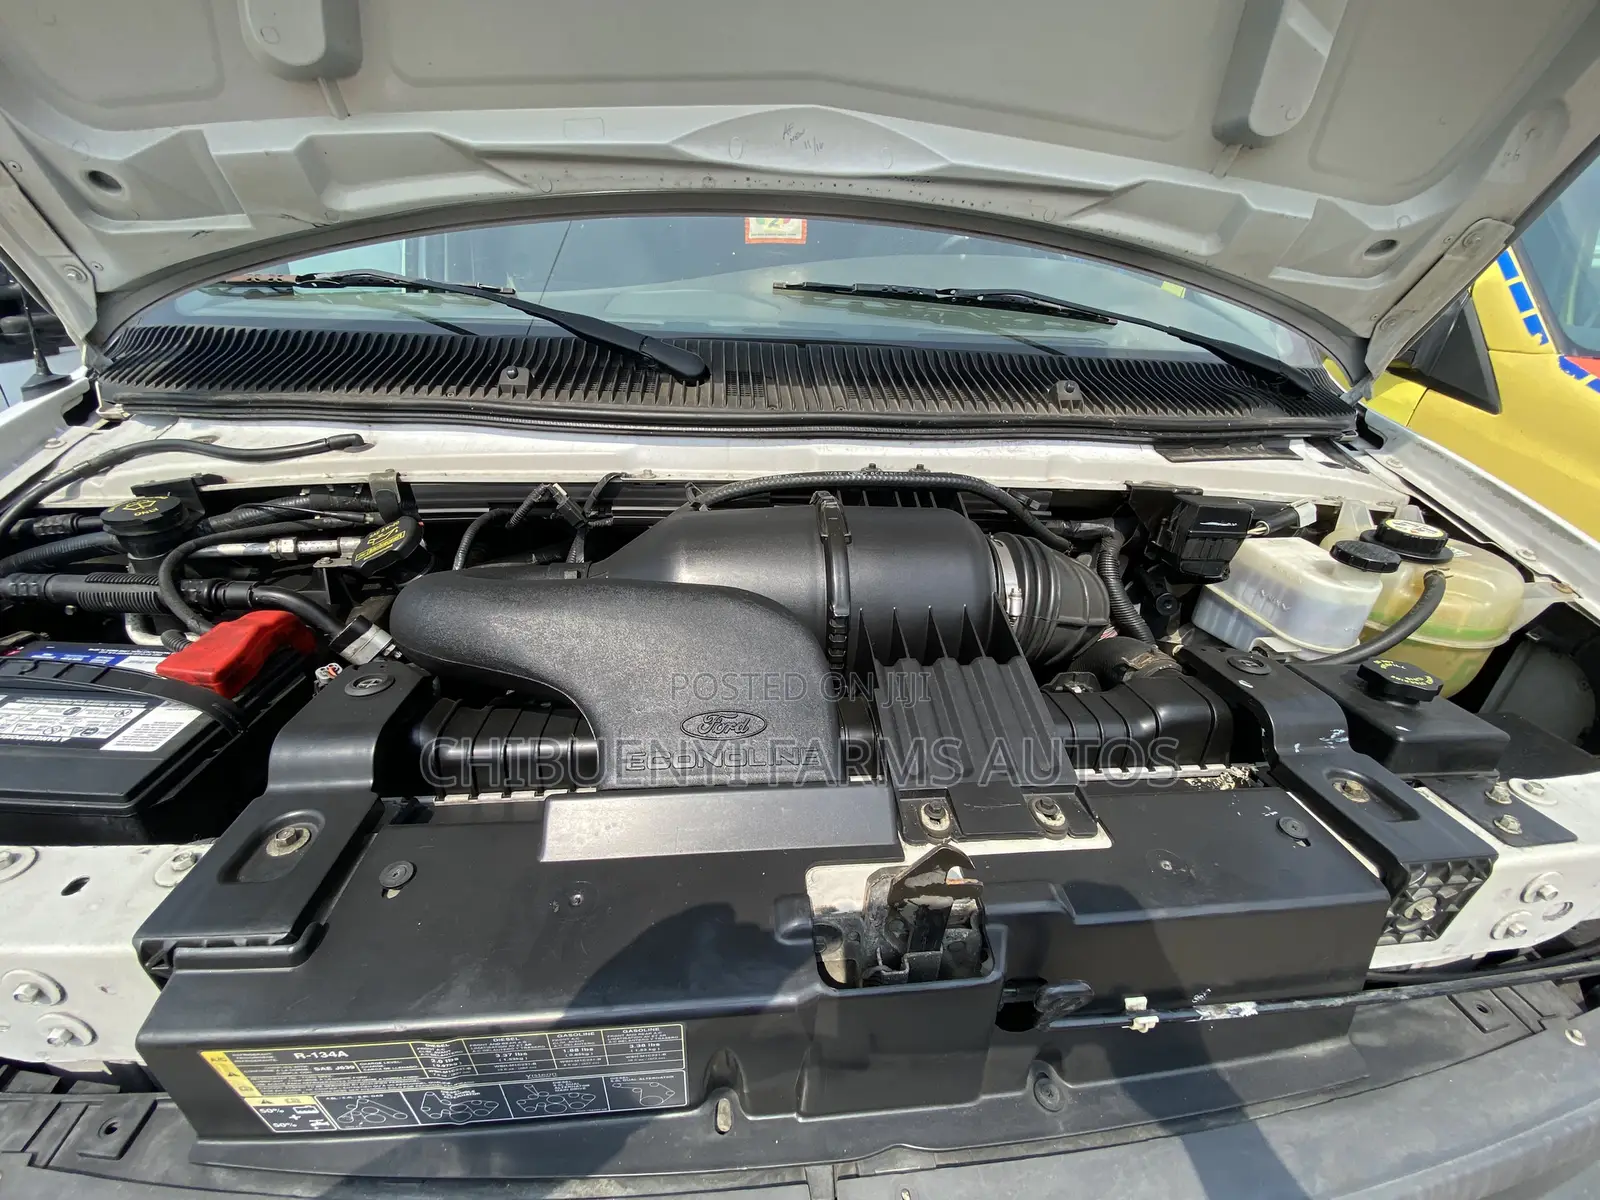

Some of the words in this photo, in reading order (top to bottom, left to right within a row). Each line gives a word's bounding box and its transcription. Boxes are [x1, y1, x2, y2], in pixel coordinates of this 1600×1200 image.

[697, 713, 751, 736] Ford
[625, 747, 821, 772] ECONOLINE
[293, 1050, 349, 1060] R-134A
